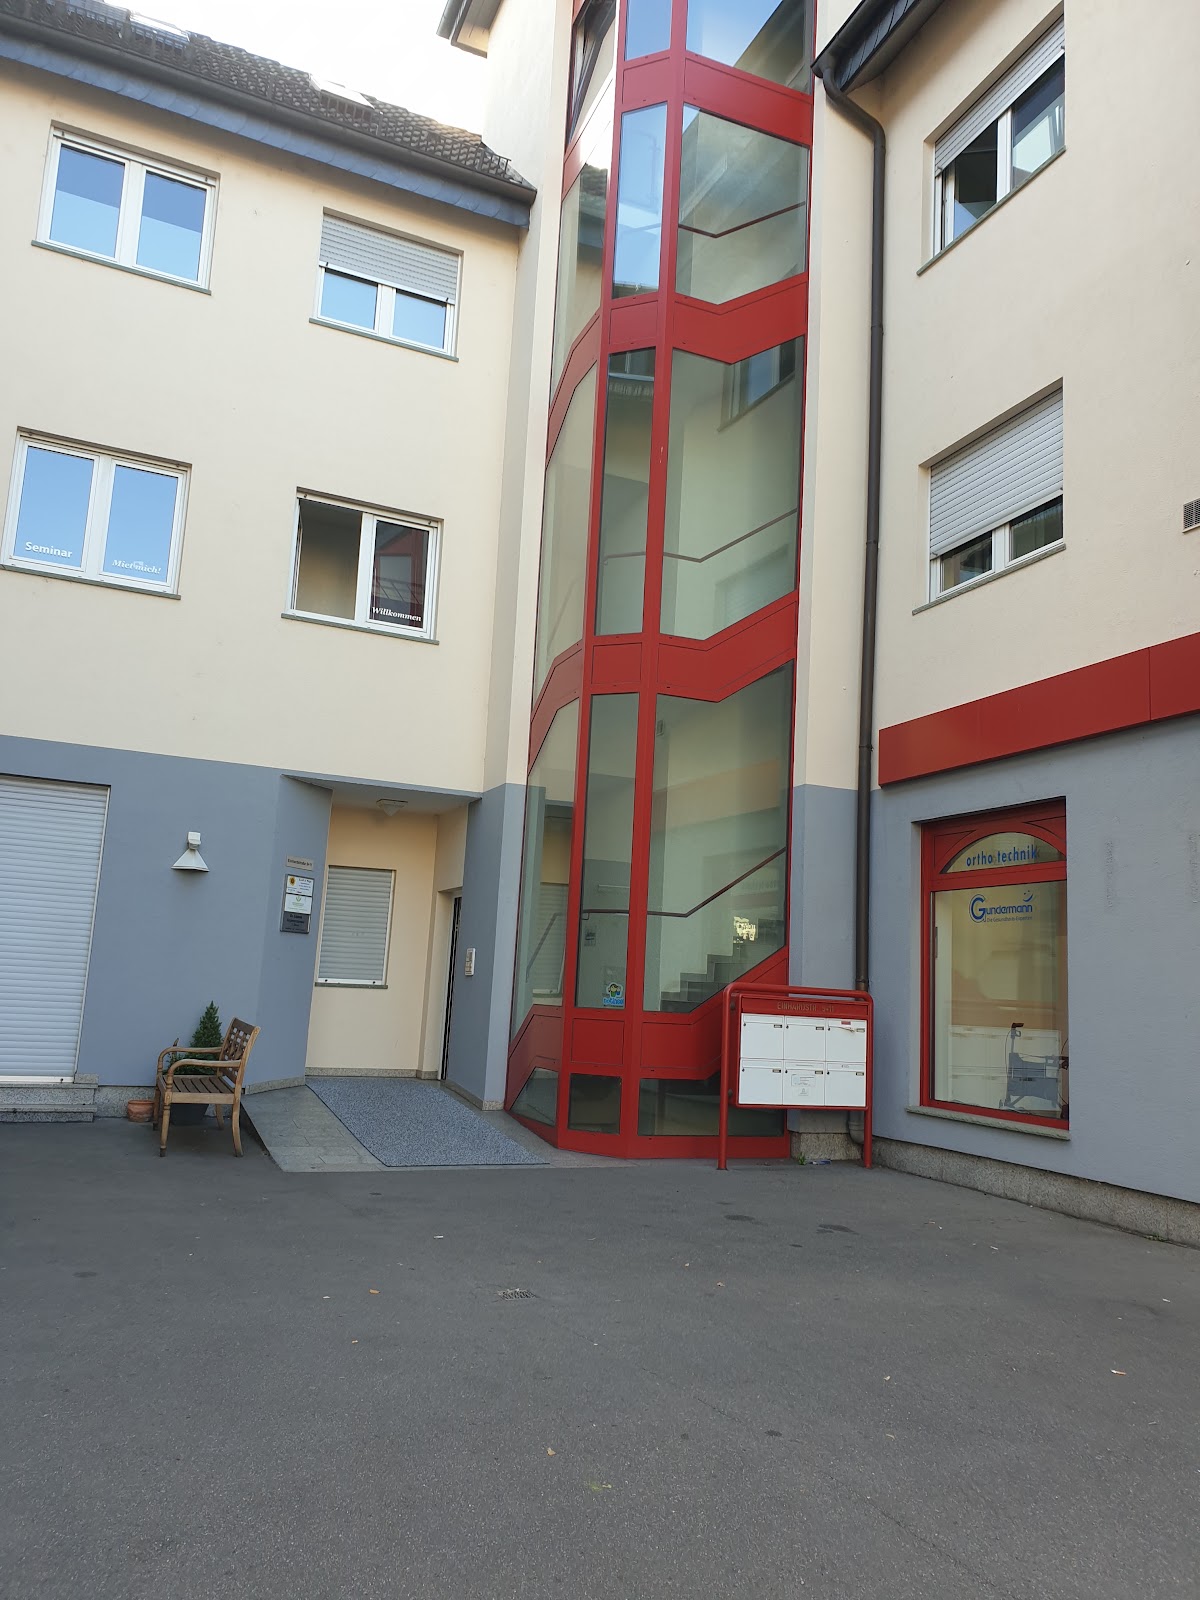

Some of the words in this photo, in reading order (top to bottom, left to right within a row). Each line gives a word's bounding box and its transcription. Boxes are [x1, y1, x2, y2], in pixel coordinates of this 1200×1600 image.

[25, 541, 73, 558] Seminar
[372, 606, 422, 622] Willkommen
[966, 850, 993, 867] ortho
[997, 844, 1038, 863] technik
[969, 894, 1033, 923] Gundermann
